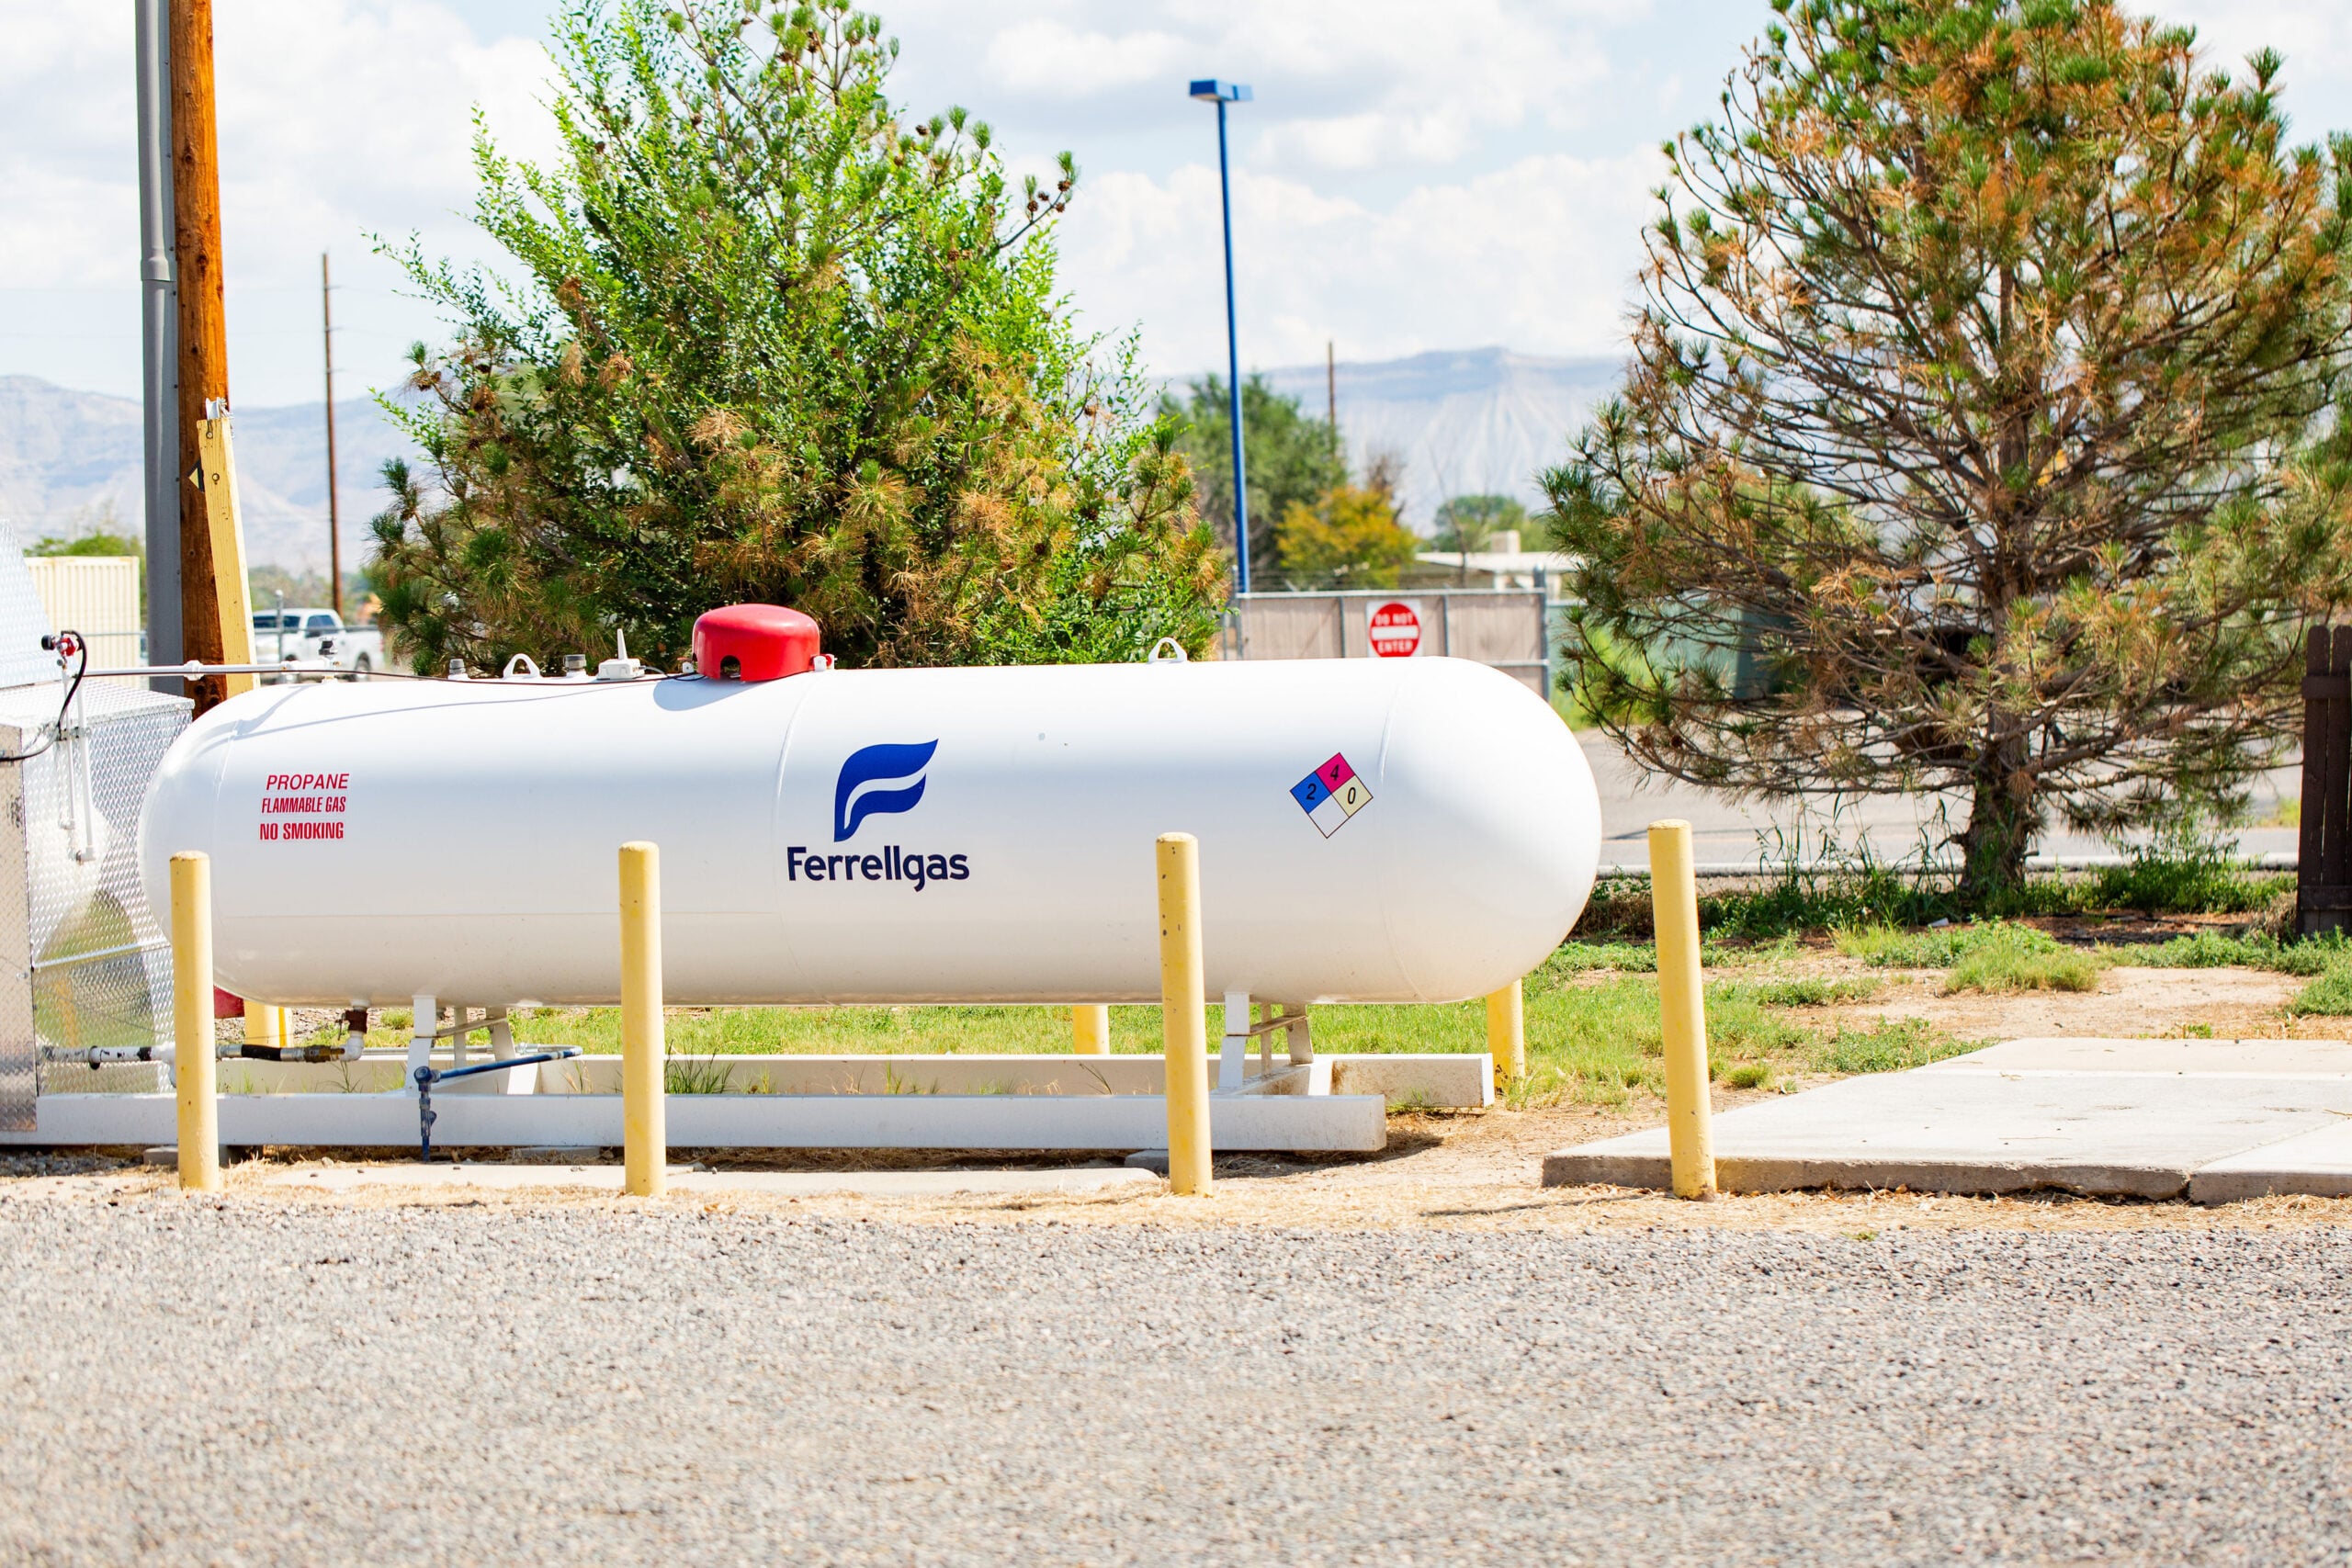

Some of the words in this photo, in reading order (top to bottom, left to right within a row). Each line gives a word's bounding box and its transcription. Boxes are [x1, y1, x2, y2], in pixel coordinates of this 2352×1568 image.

[1374, 613, 1390, 626] DO
[1392, 612, 1413, 625] NOT
[1377, 639, 1413, 653] ENTER
[1329, 764, 1340, 781] 4
[266, 773, 350, 791] PROPANE
[1306, 783, 1317, 800] 2
[1347, 786, 1356, 805] 0
[261, 796, 322, 814] FLAMMABLE
[325, 795, 346, 813] GAS
[259, 822, 278, 840] NO
[282, 821, 345, 840] SMOKING
[786, 844, 970, 893] Ferrellgas
